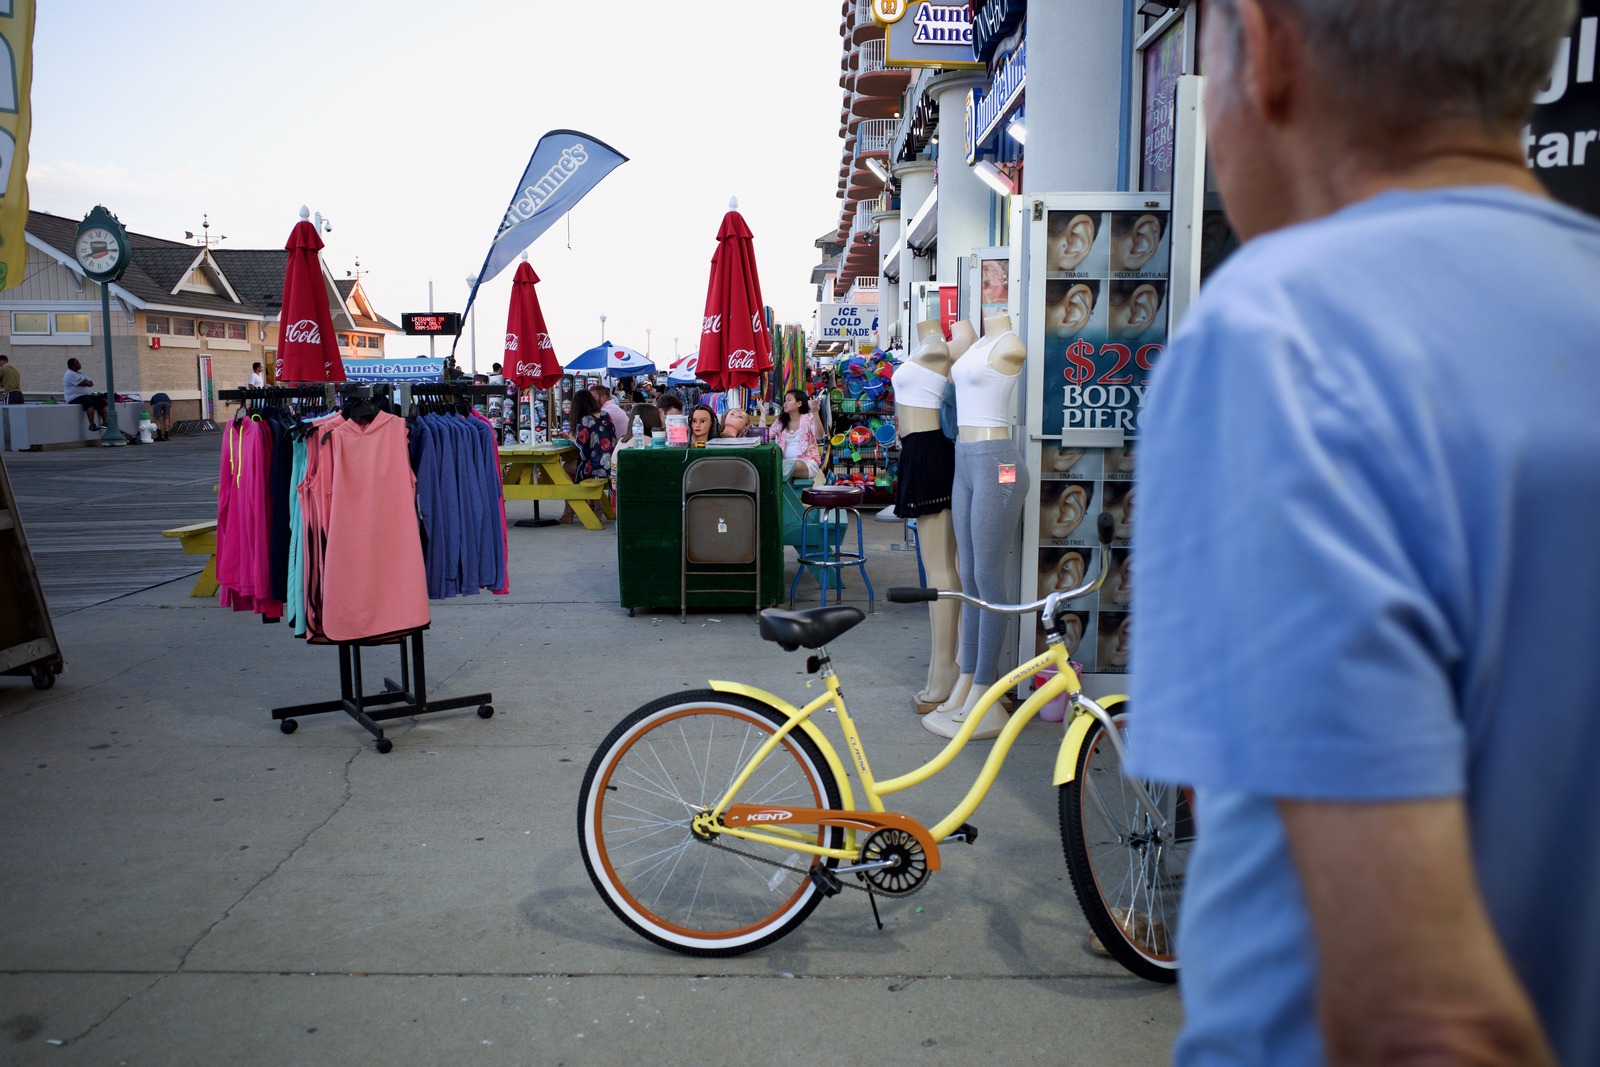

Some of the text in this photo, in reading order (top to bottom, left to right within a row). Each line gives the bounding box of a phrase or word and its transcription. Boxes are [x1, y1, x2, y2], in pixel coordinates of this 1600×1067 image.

[918, 4, 970, 23] Aunt
[917, 24, 972, 41] Anne
[1145, 125, 1173, 155] PIERC
[1520, 124, 1600, 169] tar
[838, 308, 858, 316] ICE
[831, 318, 861, 326] COLD
[1062, 385, 1148, 407] BODY
[1062, 408, 1148, 430] PIERC
[747, 810, 791, 821] KENT
